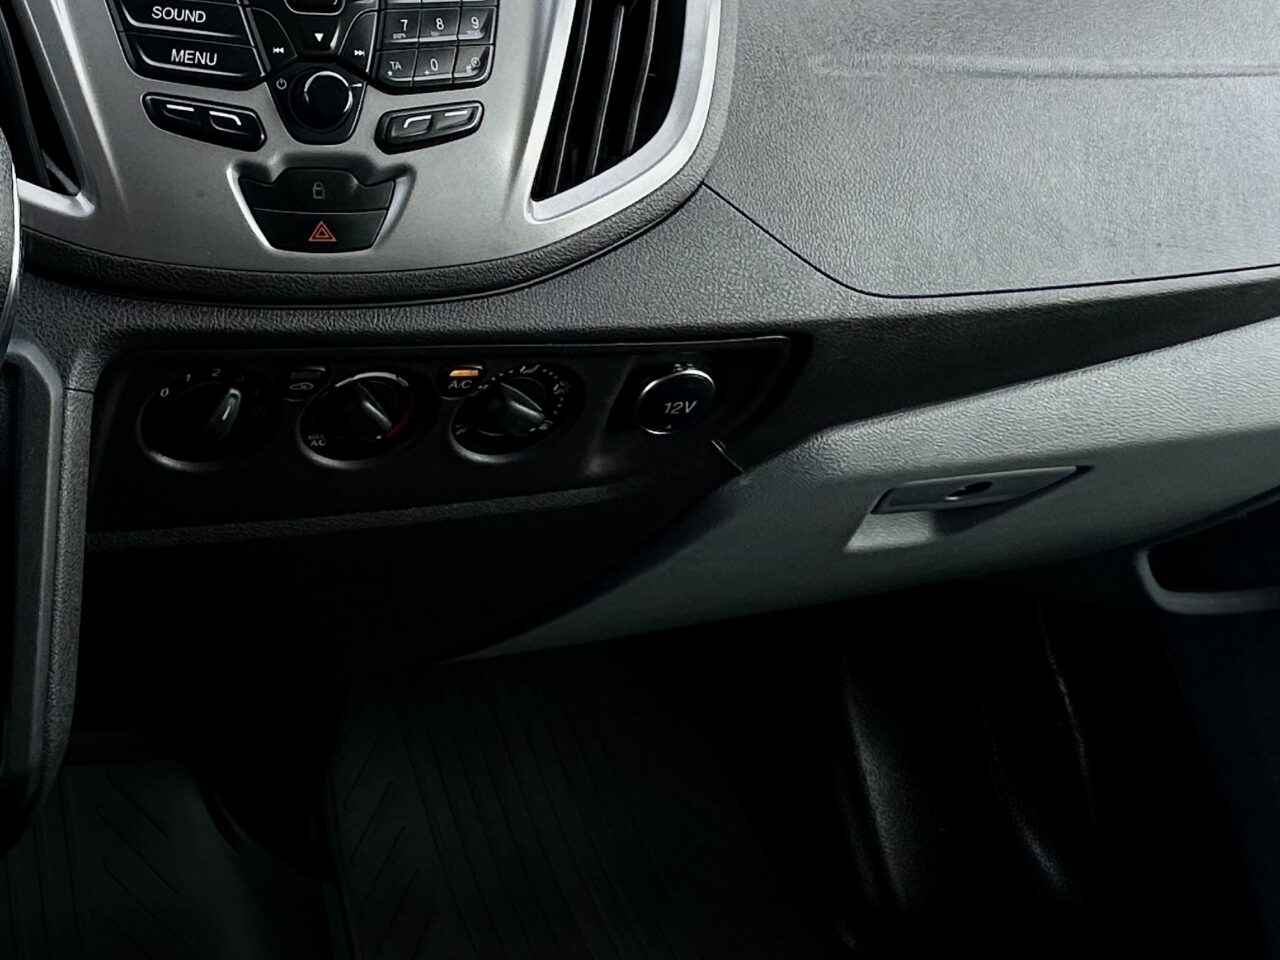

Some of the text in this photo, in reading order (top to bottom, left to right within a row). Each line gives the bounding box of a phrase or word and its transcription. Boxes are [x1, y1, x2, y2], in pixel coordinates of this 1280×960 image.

[151, 6, 207, 23] SOUND
[400, 19, 409, 31] 7
[435, 17, 445, 30] 8
[471, 16, 480, 29] 9
[171, 49, 218, 66] MENU
[389, 61, 403, 71] TA
[430, 58, 439, 71] 0
[211, 369, 221, 377] 2
[160, 388, 169, 397] 0
[664, 400, 698, 415] 12V
